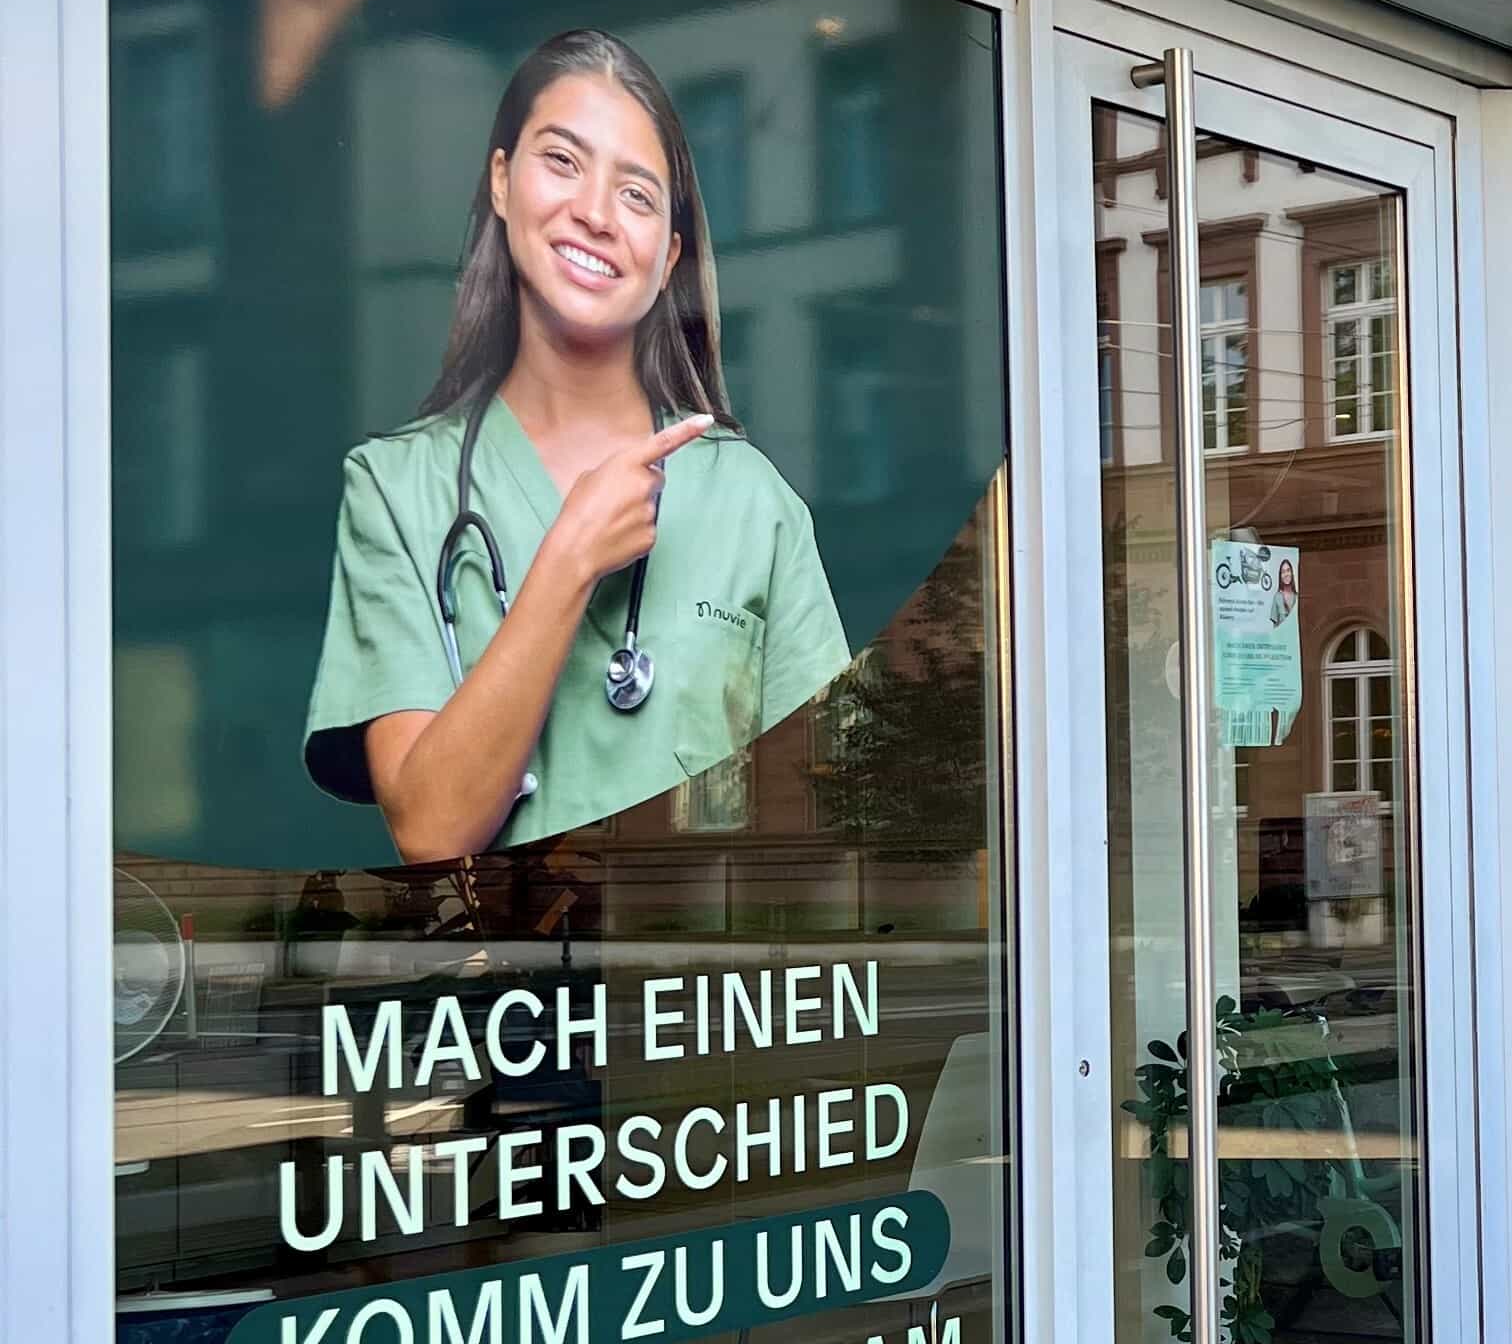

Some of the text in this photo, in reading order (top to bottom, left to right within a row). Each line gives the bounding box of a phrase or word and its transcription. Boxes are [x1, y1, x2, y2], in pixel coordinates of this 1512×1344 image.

[713, 608, 746, 629] nuvie
[322, 960, 880, 1097] MACH EINEN
[278, 1082, 911, 1253] UNTERSCHIED
[620, 1238, 725, 1340] ZU
[756, 1205, 913, 1312] UNS
